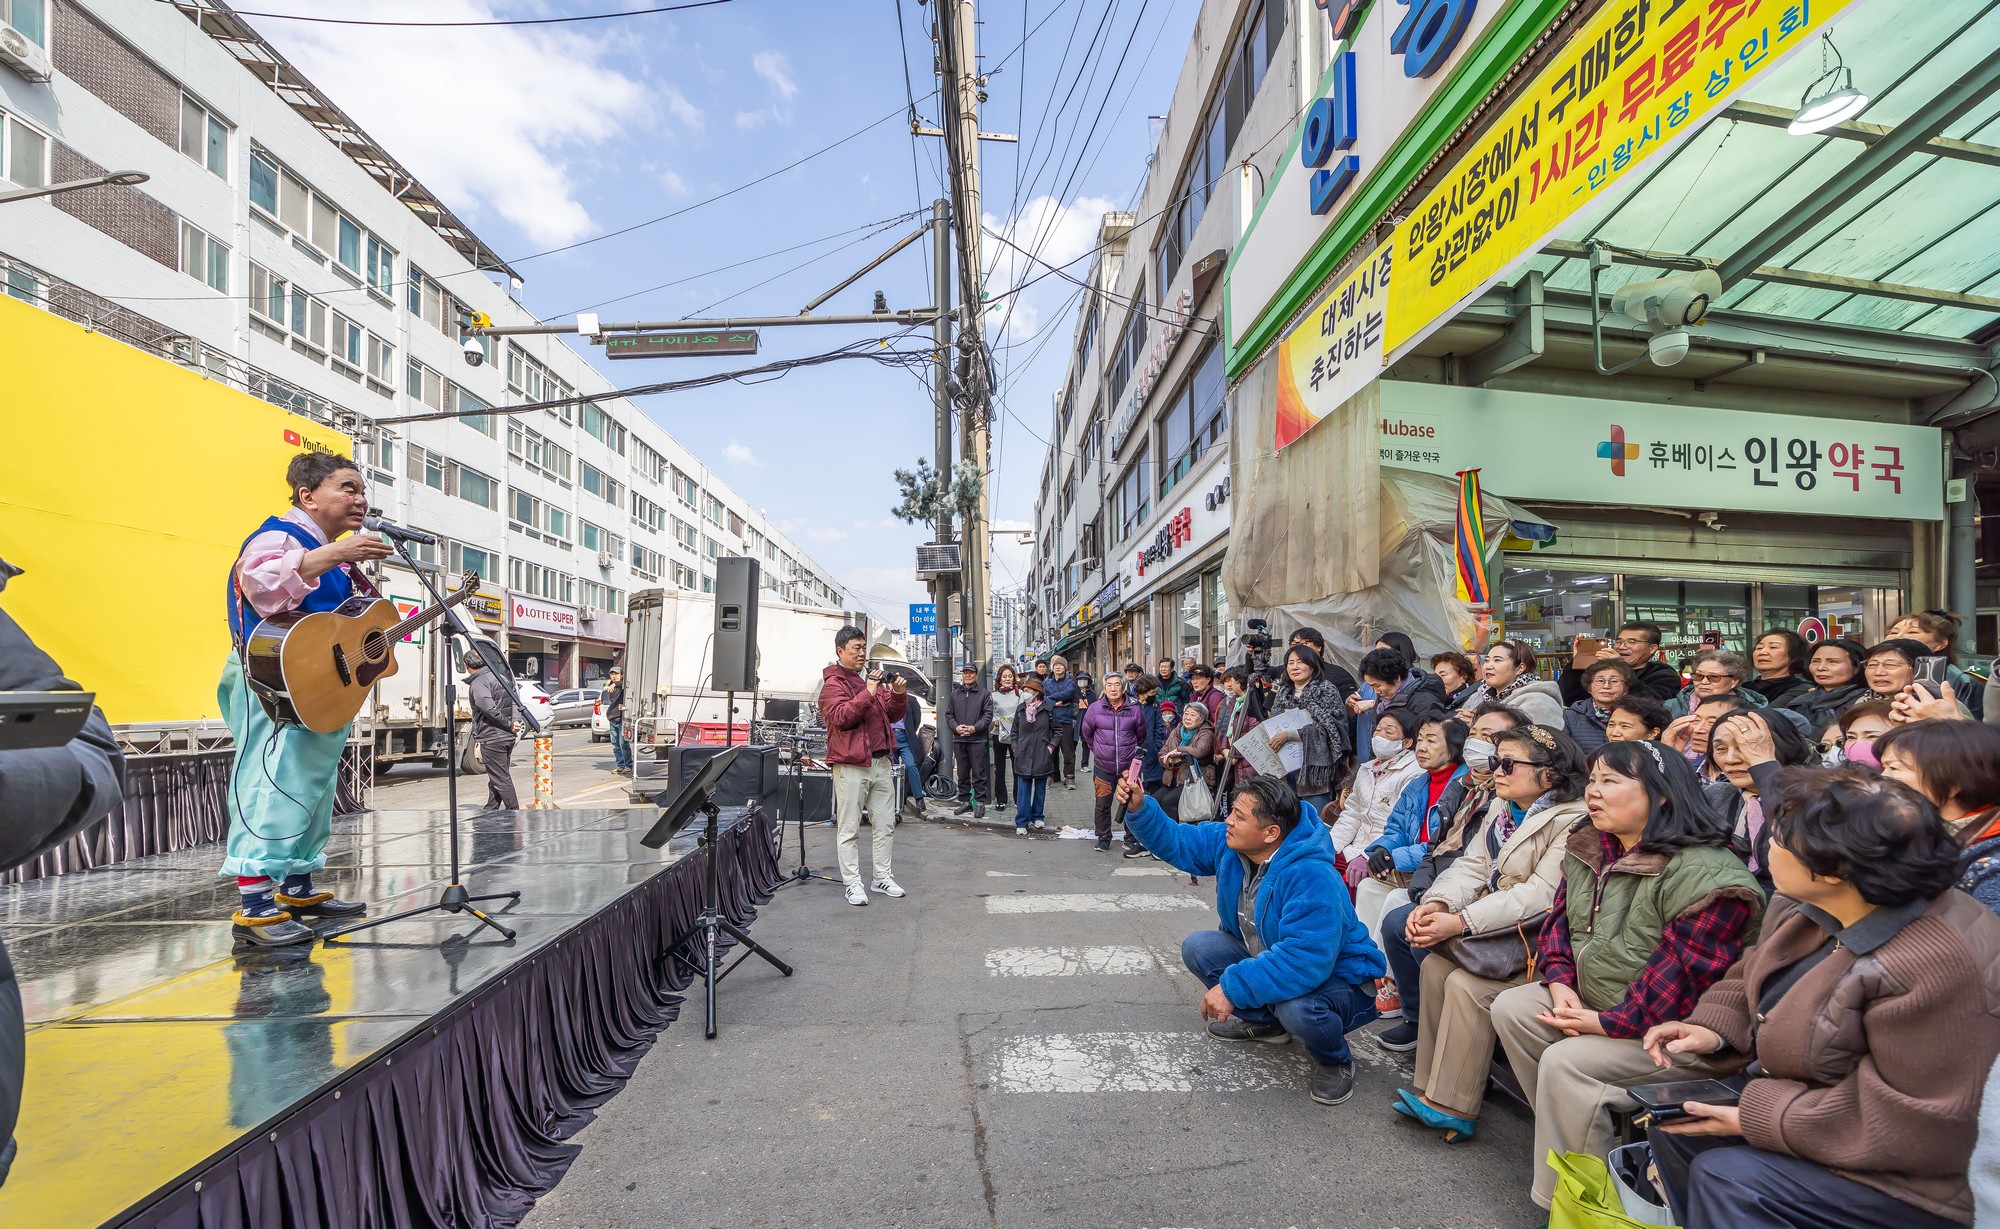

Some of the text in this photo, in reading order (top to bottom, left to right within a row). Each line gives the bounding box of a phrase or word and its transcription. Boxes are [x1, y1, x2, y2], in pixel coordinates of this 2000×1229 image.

[1704, 0, 1809, 98] 상인회
[1408, 0, 1650, 261] 인왕시장에서 구매한
[1430, 0, 1762, 287] 상관없이 1시간 무료주
[1201, 257, 1210, 272] 2F
[1310, 310, 1383, 392] 추진하는
[1377, 418, 1435, 438] Hubase
[1395, 449, 1421, 462] 즐거운
[1422, 451, 1440, 463] 약국
[1648, 436, 1905, 495] 휴베이스 인왕약국
[525, 607, 574, 625] LOTTE SUPER
